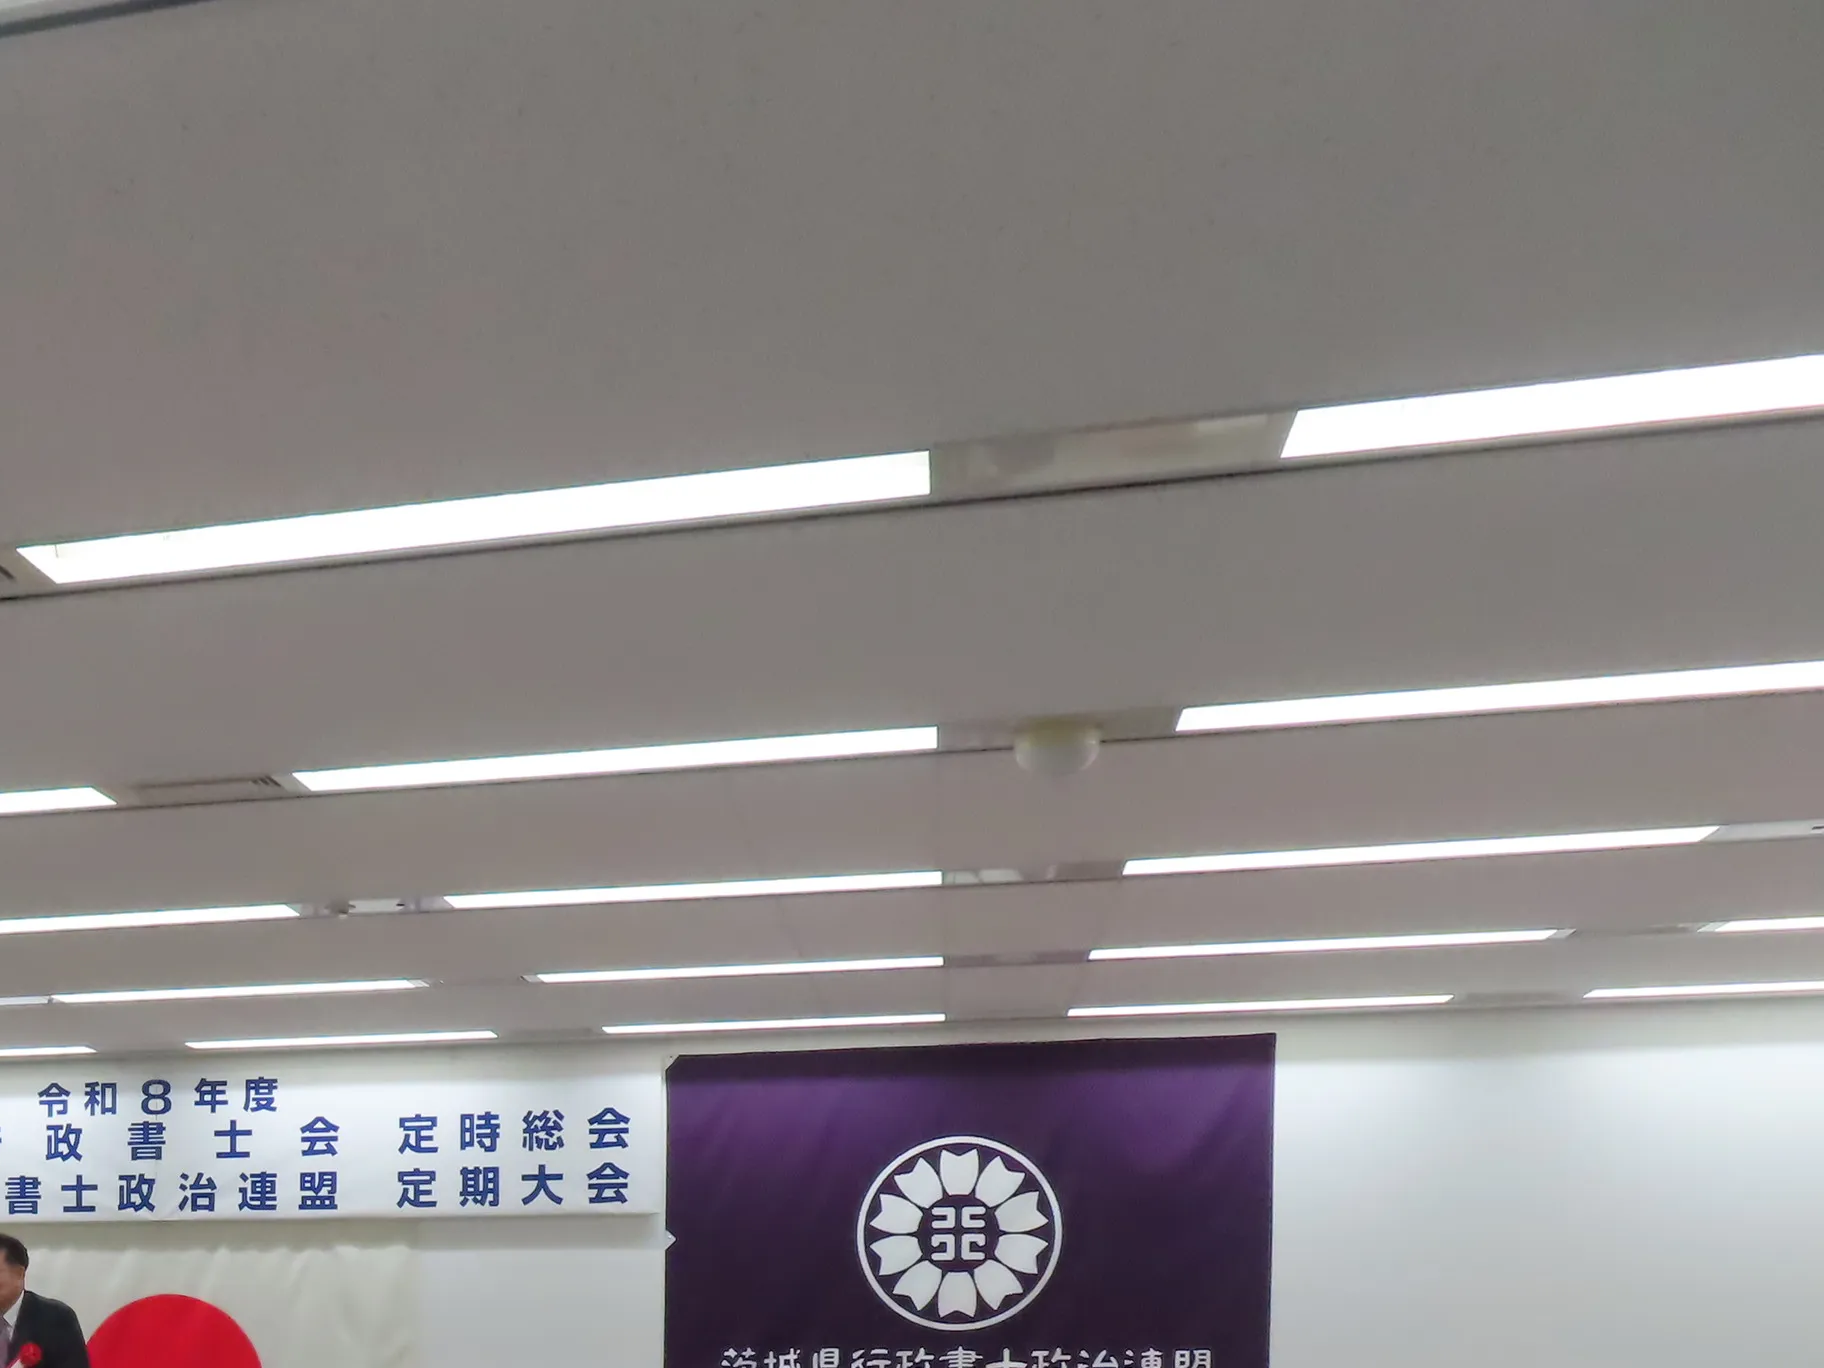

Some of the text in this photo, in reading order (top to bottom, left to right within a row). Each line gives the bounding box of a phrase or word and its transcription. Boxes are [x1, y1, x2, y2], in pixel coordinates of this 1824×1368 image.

[37, 1076, 280, 1118] 令和8年度
[398, 1107, 631, 1154] 定時総会
[397, 1162, 631, 1209] 定期大会
